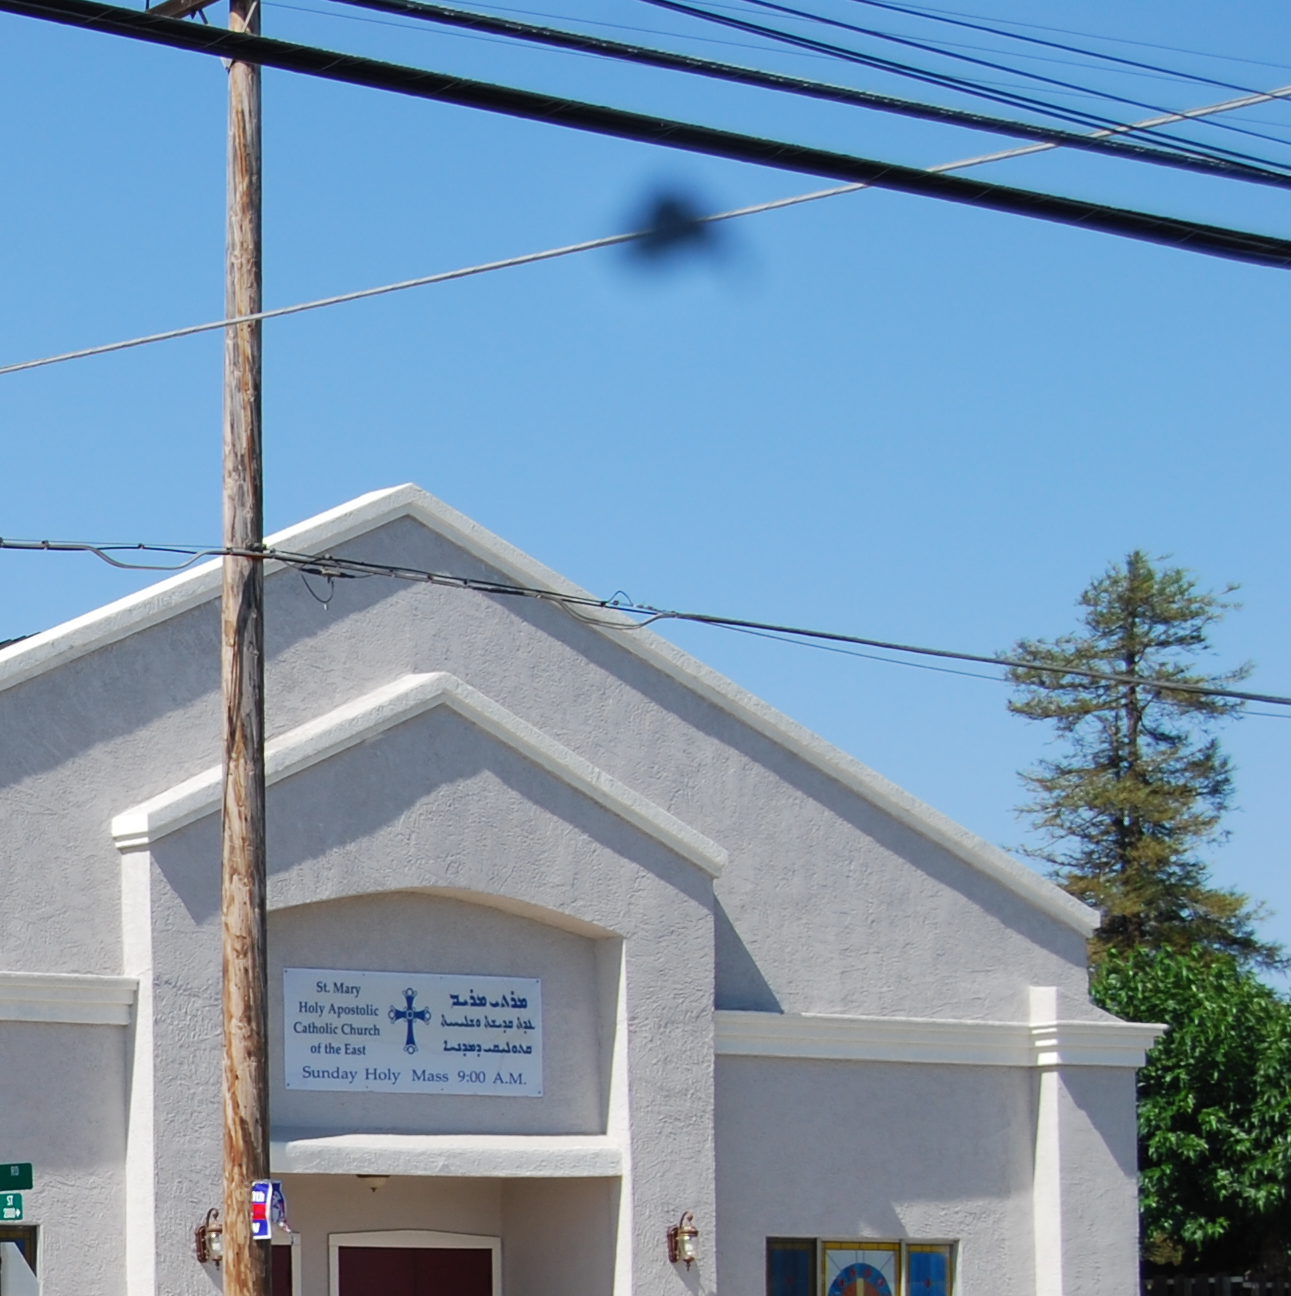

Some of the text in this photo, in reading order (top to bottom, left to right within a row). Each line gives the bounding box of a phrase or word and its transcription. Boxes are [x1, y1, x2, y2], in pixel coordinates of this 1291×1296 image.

[316, 981, 361, 998] St. Mary
[298, 1001, 379, 1018] Holy Apostolic
[293, 1021, 380, 1036] Catholic Church
[310, 1042, 366, 1055] of the East
[302, 1066, 527, 1086] Sunday Holy Mass 9:00 A.M.
[11, 1166, 19, 1176] RD
[6, 1195, 14, 1206] ST
